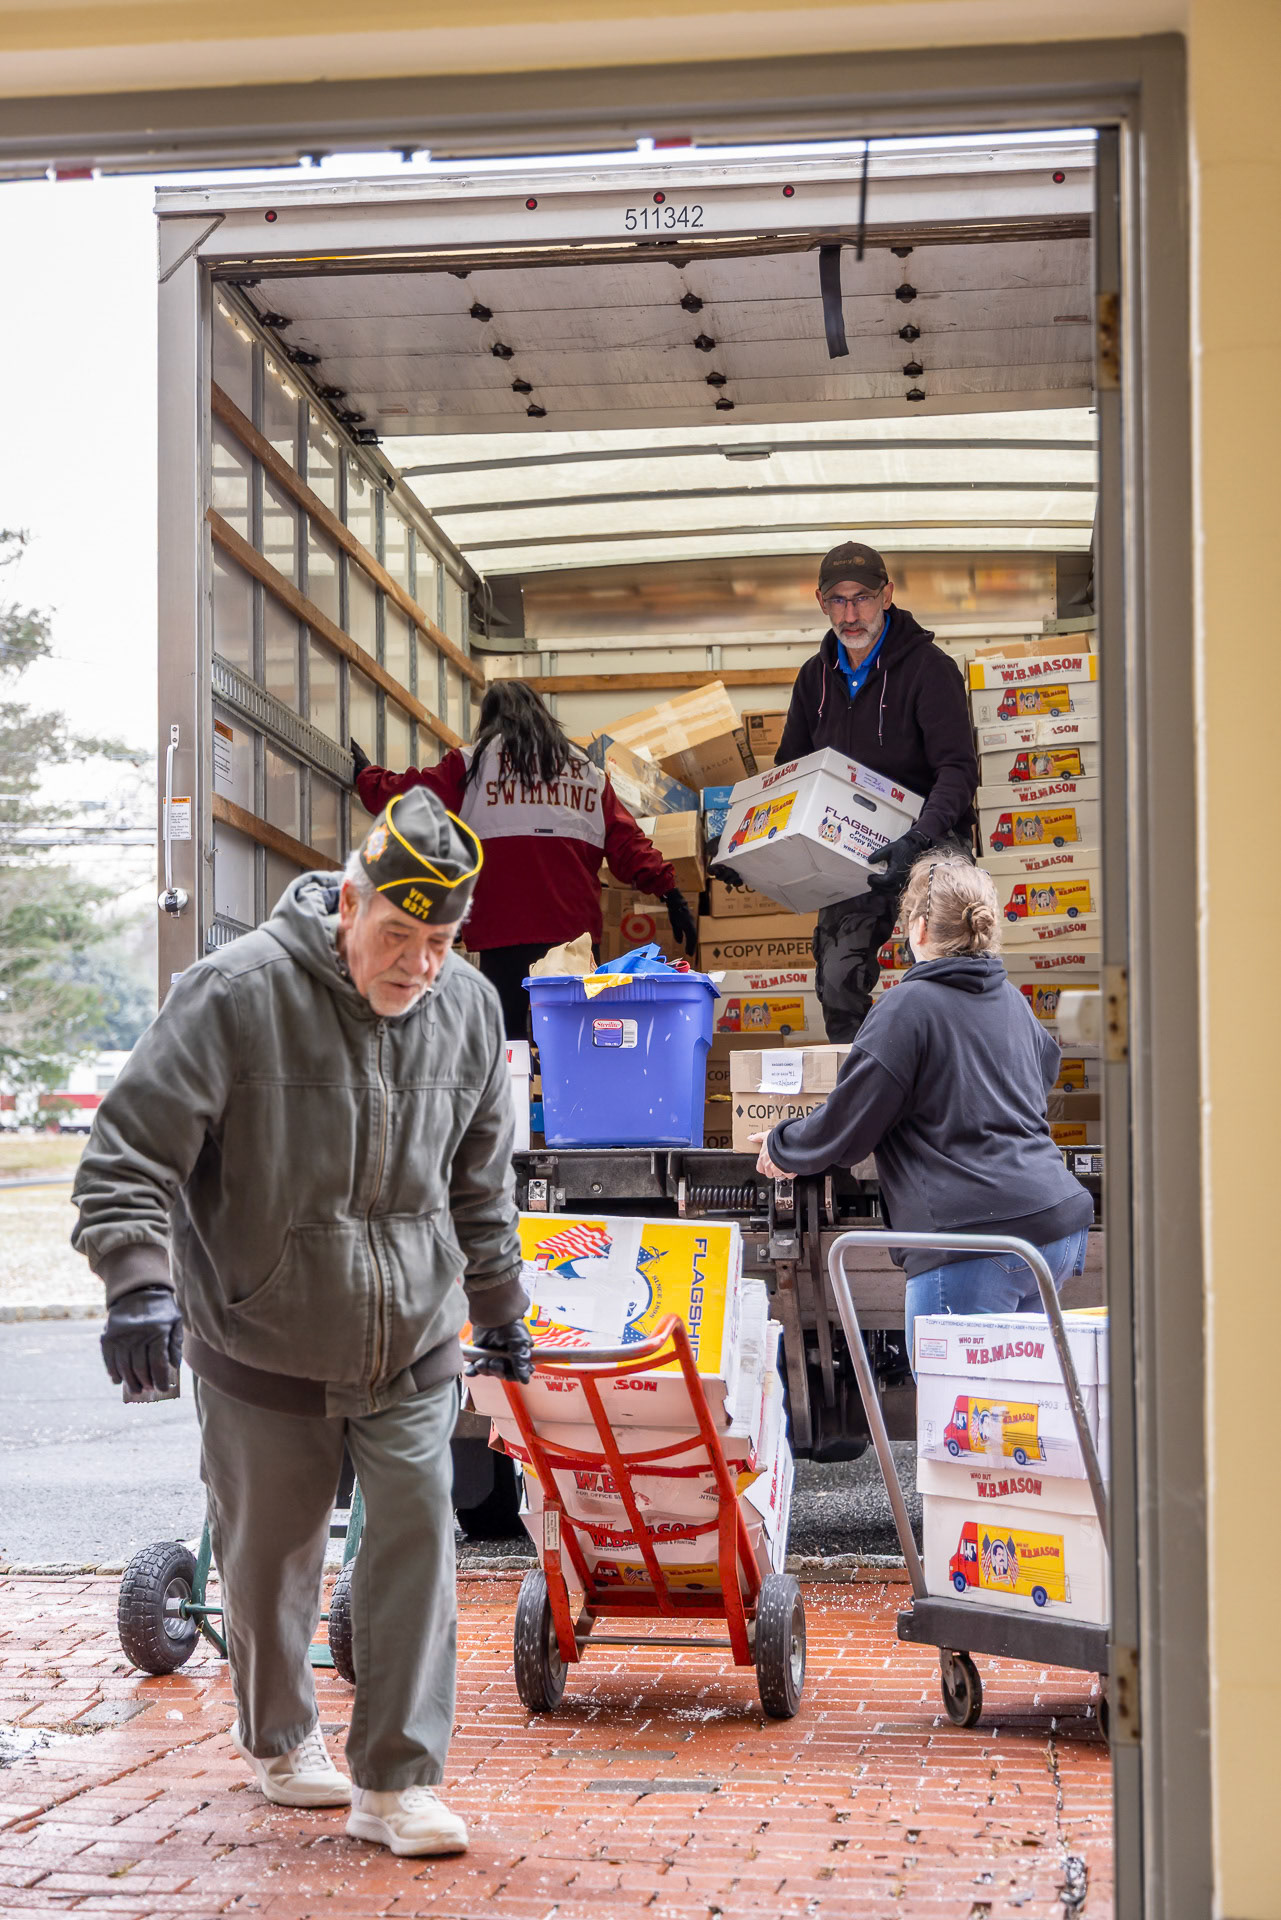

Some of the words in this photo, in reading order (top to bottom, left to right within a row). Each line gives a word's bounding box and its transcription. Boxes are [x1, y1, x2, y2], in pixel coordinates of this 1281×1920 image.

[625, 205, 703, 230] 511342
[486, 780, 597, 813] SWIMMING
[825, 806, 891, 843] FLAGSHIP
[849, 833, 866, 846] Copy
[855, 830, 883, 848] Premium
[409, 887, 433, 909] VFW
[723, 944, 763, 958] COPY
[768, 942, 814, 956] PAPER
[750, 973, 808, 989] W.B.MASON
[707, 1070, 731, 1081] COP
[747, 1104, 783, 1119] COPY
[788, 1105, 814, 1119] PAP
[703, 1135, 732, 1149] OP
[959, 1336, 971, 1344] WHO
[972, 1337, 984, 1345] BUT
[966, 1341, 1045, 1365] W.B.MASON
[970, 1472, 981, 1480] WHO
[976, 1477, 1042, 1498] W.B.MASON
